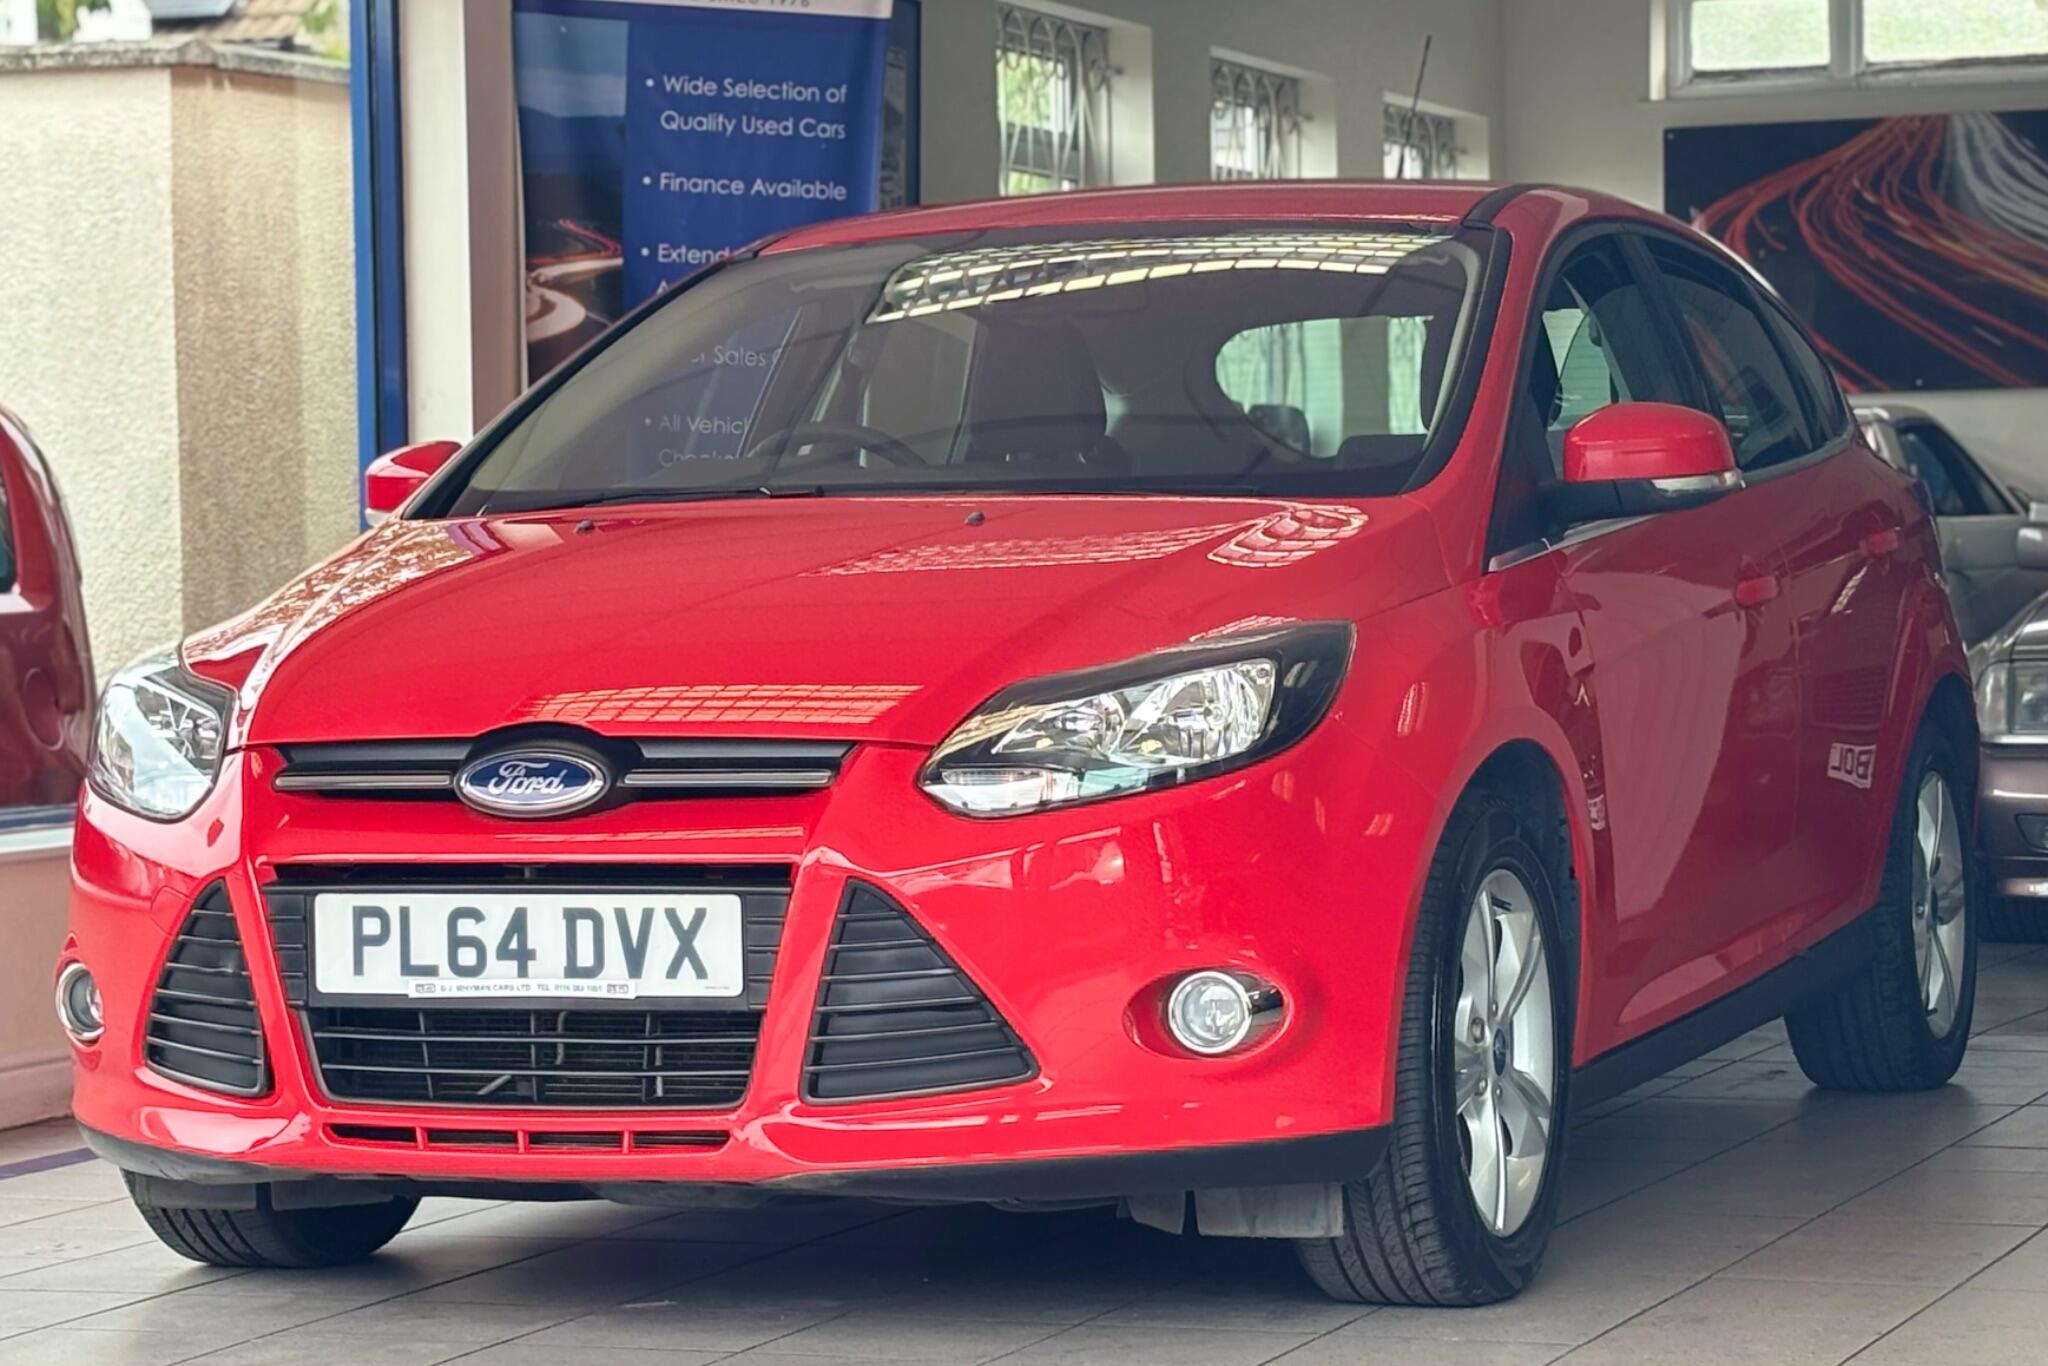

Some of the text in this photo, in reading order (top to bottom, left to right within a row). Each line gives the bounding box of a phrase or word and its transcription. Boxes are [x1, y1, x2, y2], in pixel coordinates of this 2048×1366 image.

[663, 74, 848, 103] Wide Selection of
[660, 110, 847, 139] Quality Used Cars
[659, 172, 847, 201] Finance Available
[713, 345, 767, 367] Sales
[659, 414, 681, 432] All
[488, 760, 568, 795] Ford
[352, 905, 709, 980] PL64 DVX
